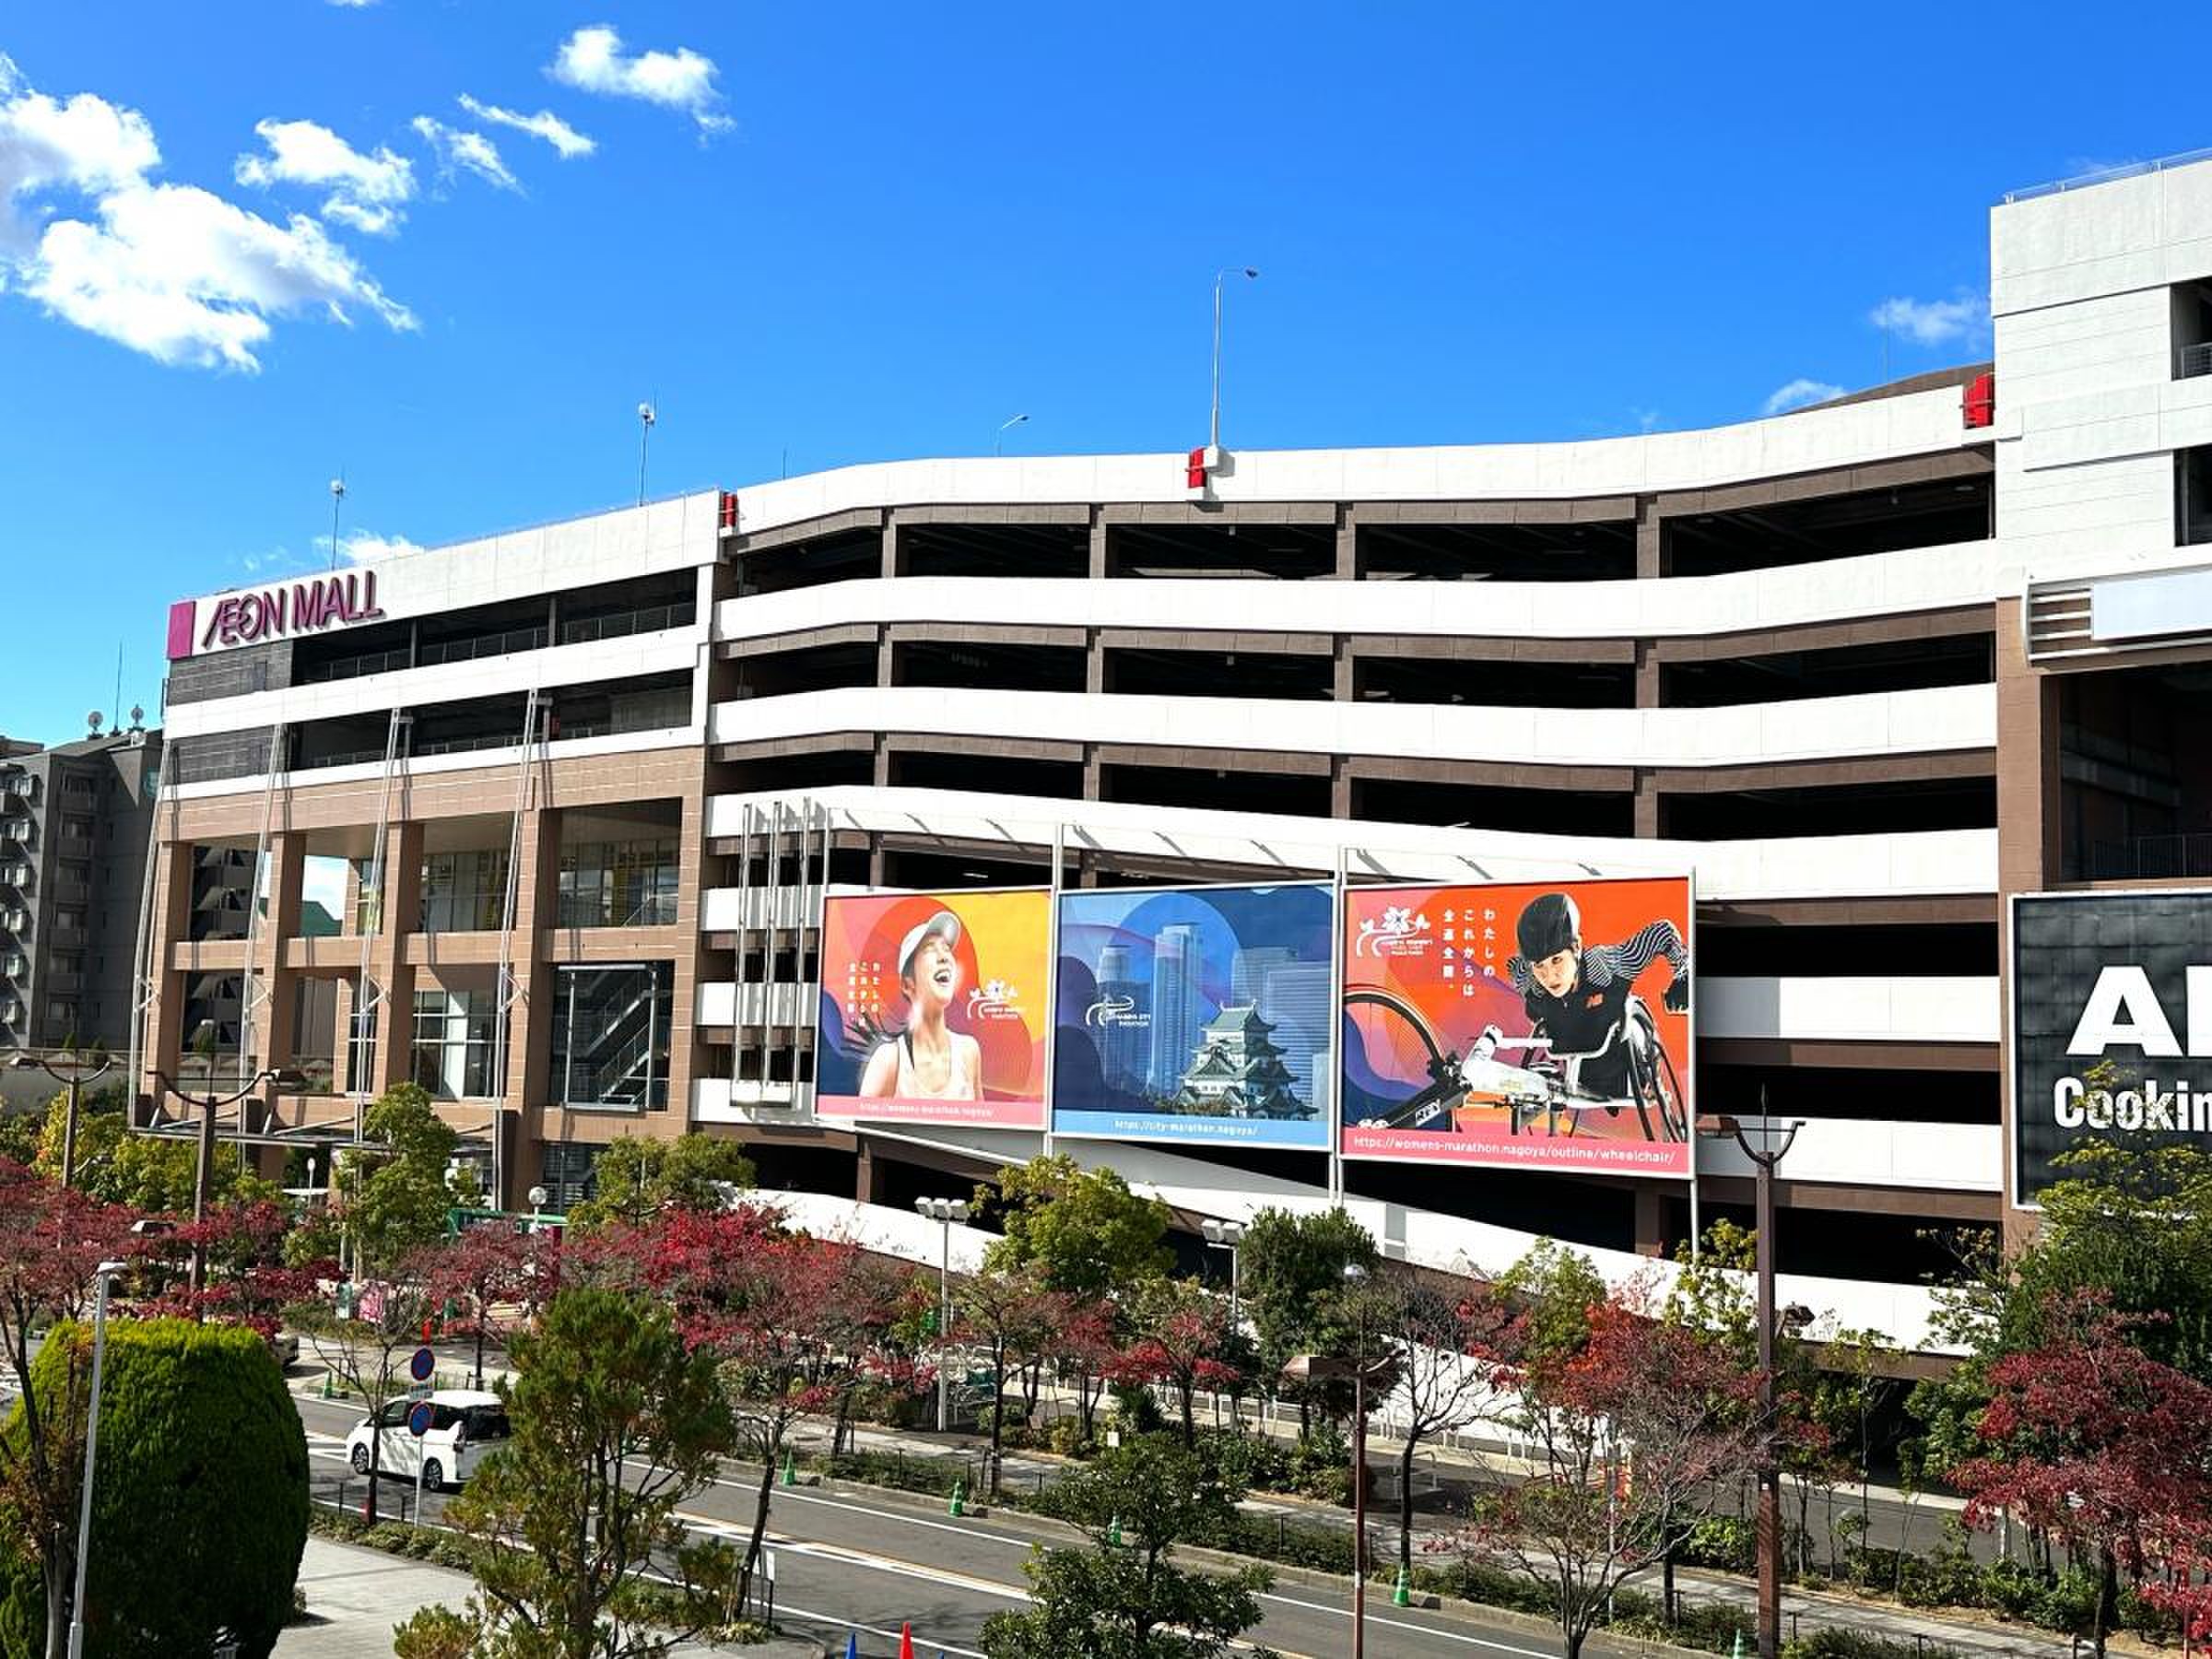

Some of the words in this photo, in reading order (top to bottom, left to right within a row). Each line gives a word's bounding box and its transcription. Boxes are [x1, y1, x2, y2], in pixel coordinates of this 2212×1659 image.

[293, 571, 385, 631] MALL
[1463, 909, 1476, 996] これからは
[1483, 908, 1496, 978] わたしの
[2065, 966, 2212, 1057] A
